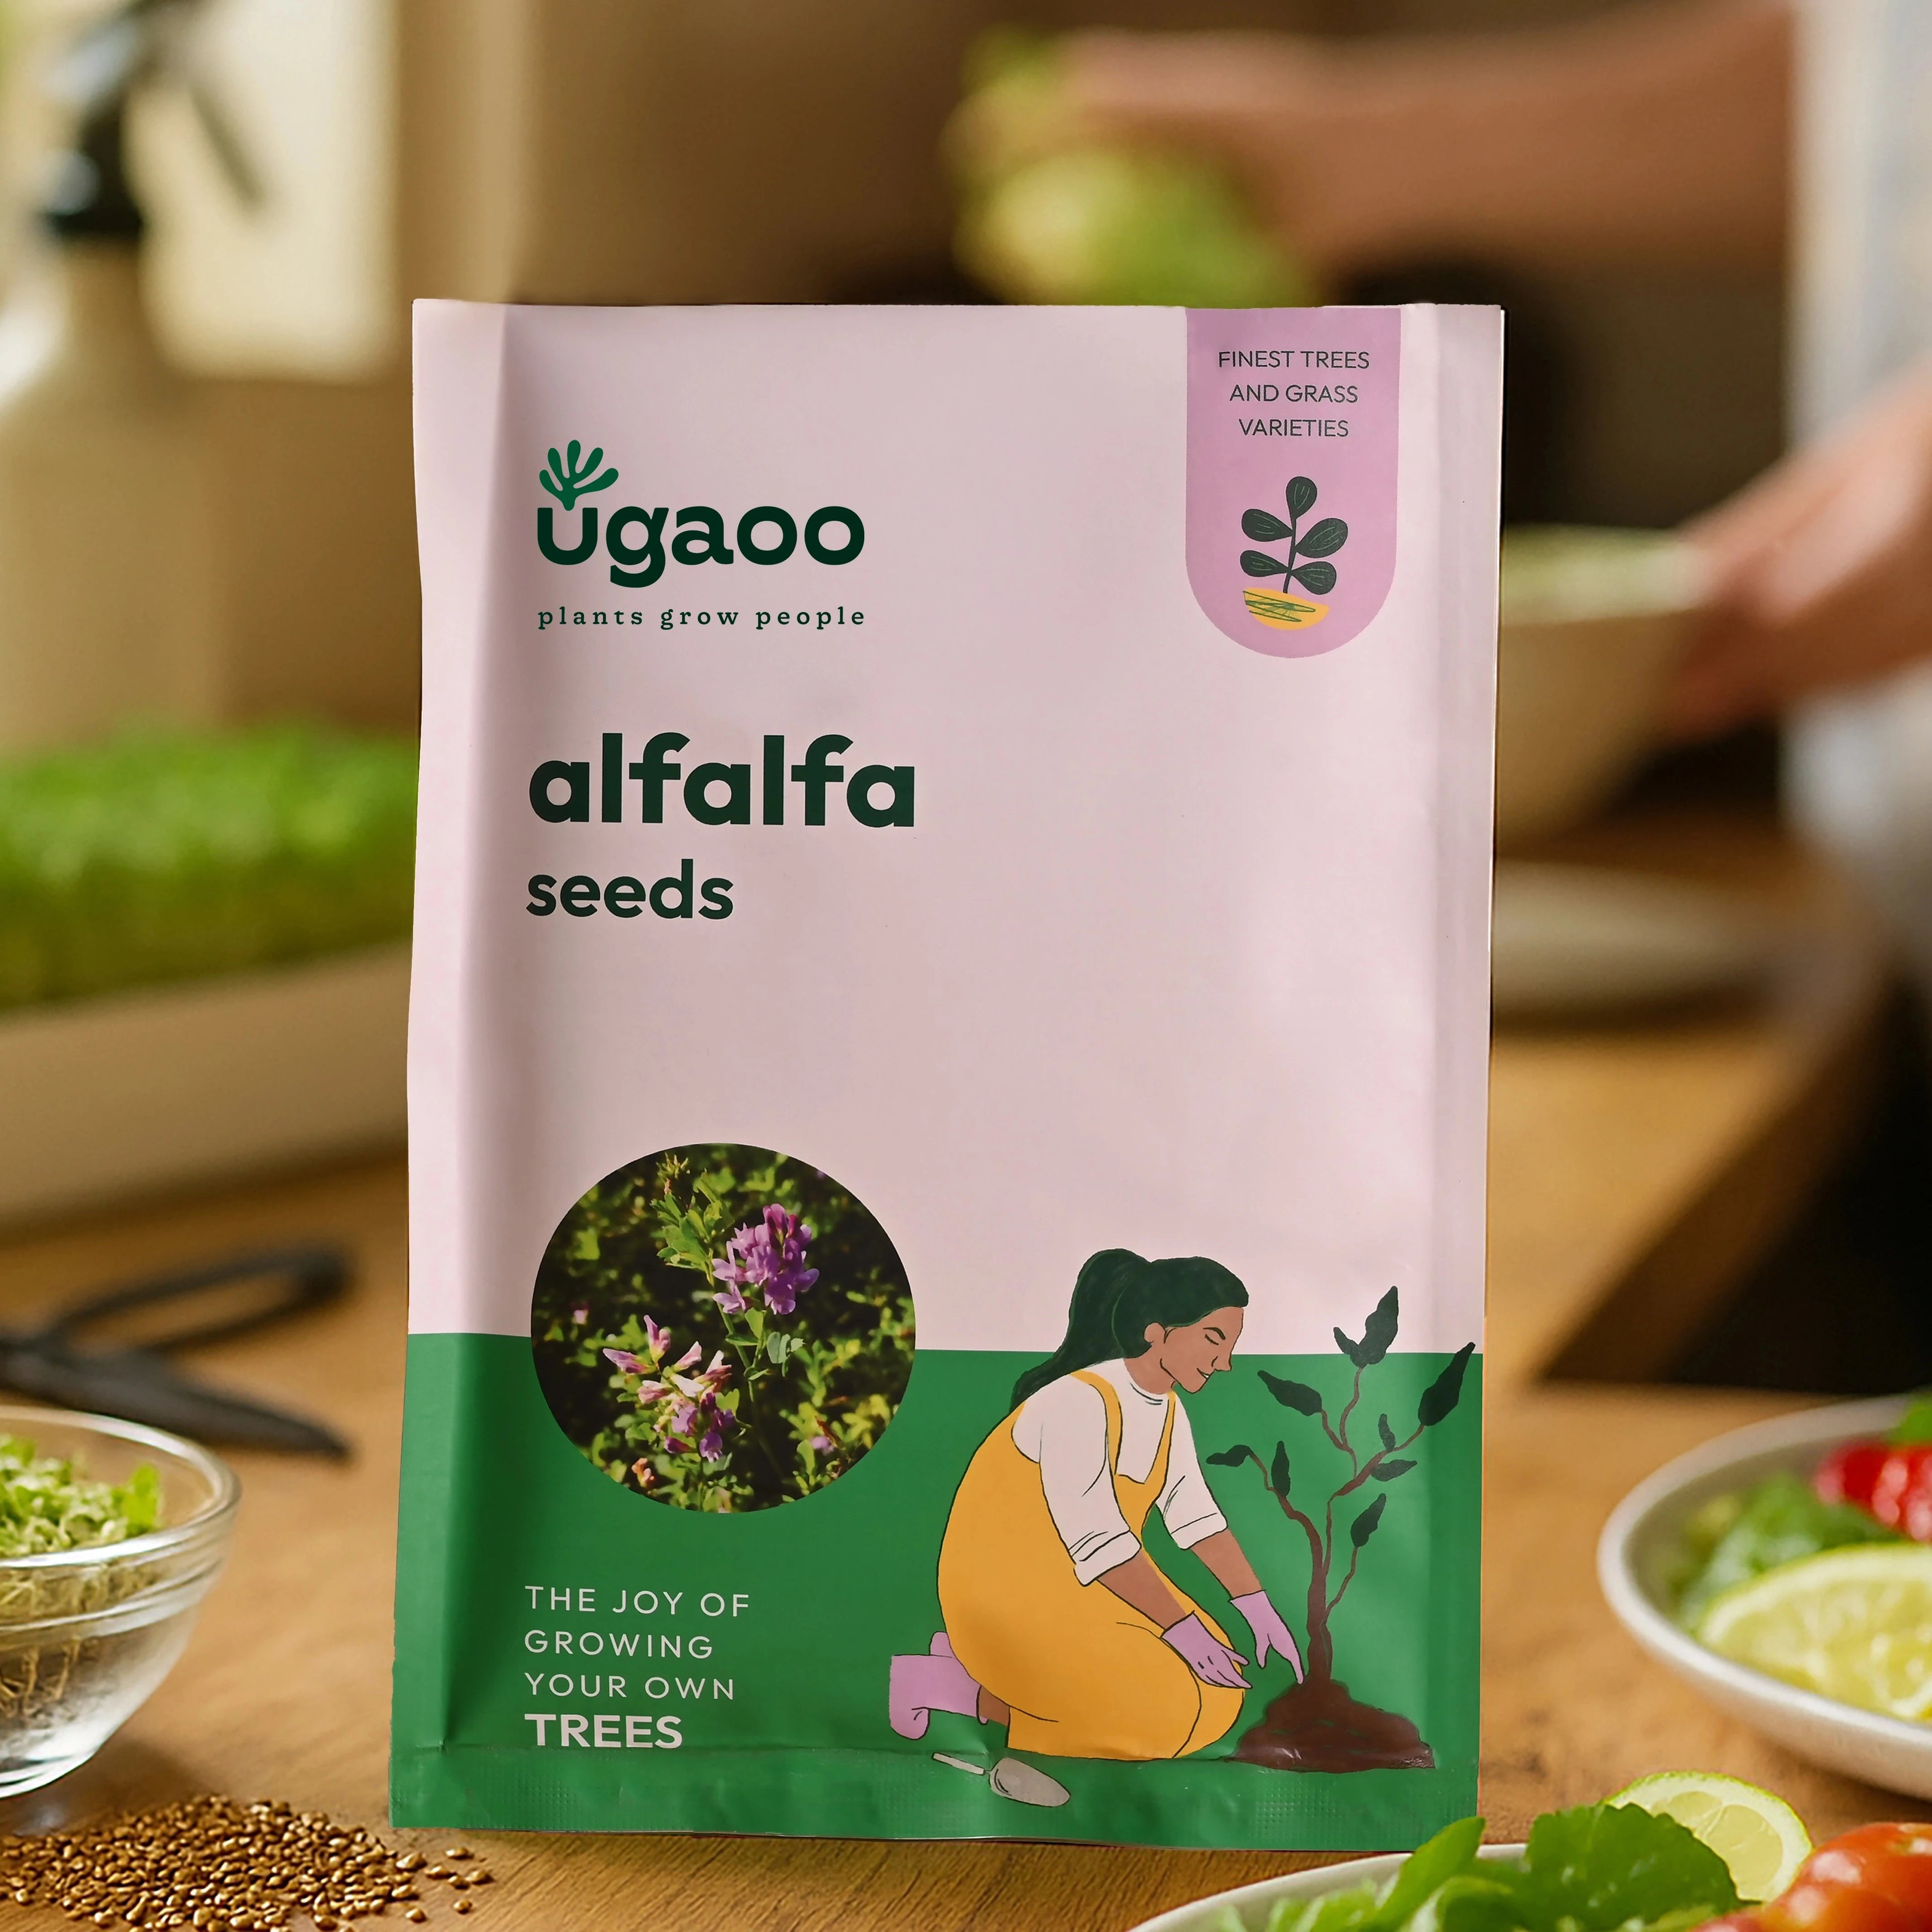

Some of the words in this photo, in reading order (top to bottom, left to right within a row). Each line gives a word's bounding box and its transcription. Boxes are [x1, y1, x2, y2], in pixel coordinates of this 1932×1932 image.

[1219, 351, 1295, 368] FINEST
[1301, 351, 1370, 369] TREES
[1230, 384, 1279, 403] AND
[1285, 385, 1358, 403] GRASS
[1239, 419, 1349, 437] VARIETIES
[537, 506, 865, 588] ugaoo
[538, 606, 644, 630] plants
[661, 608, 739, 630] grow
[755, 606, 865, 630] people
[529, 732, 915, 828] alfalfa
[526, 858, 734, 920] seeds
[525, 1585, 596, 1612] THE
[612, 1590, 683, 1615] JOY
[701, 1593, 749, 1618] OF
[525, 1630, 713, 1659] GROWING
[525, 1672, 626, 1699] YOUR
[645, 1677, 734, 1700] OWN
[525, 1714, 683, 1749] TREES
